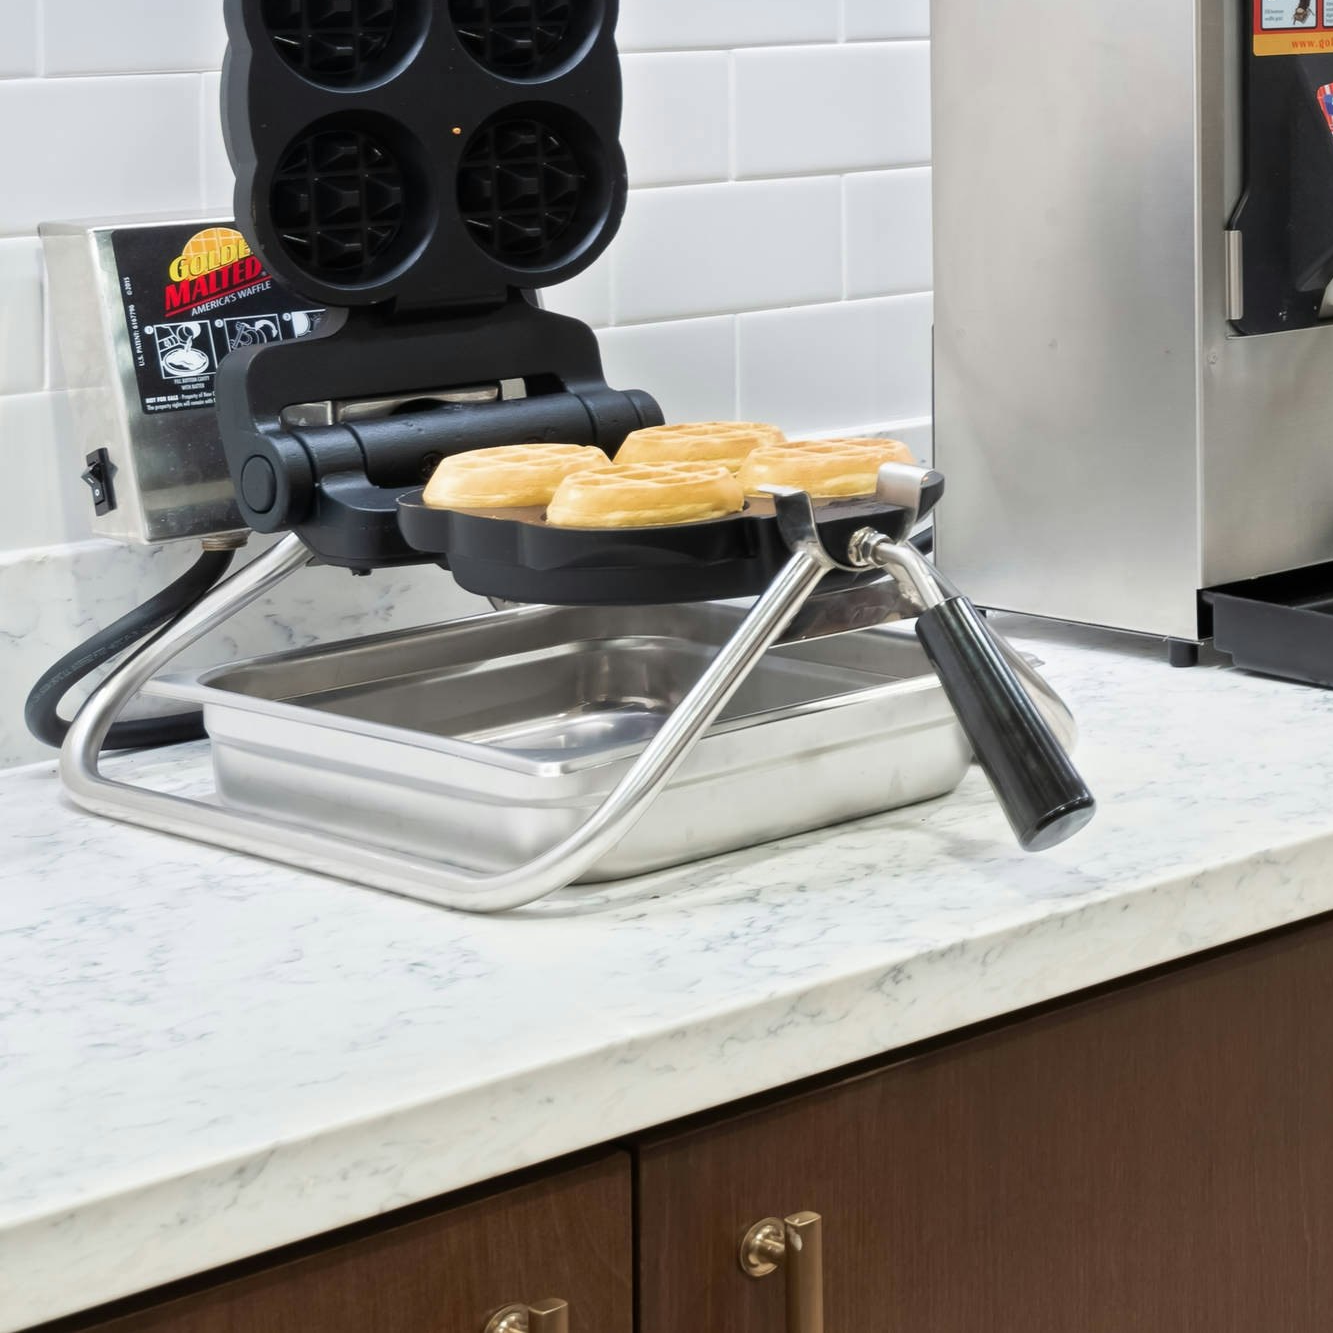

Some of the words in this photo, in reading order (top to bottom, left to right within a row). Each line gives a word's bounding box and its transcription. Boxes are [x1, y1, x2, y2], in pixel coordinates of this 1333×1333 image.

[169, 239, 251, 282] GOLDE
[165, 255, 262, 311] MALTED
[191, 294, 237, 317] AMERICA'S
[237, 280, 272, 299] WAFFLE
